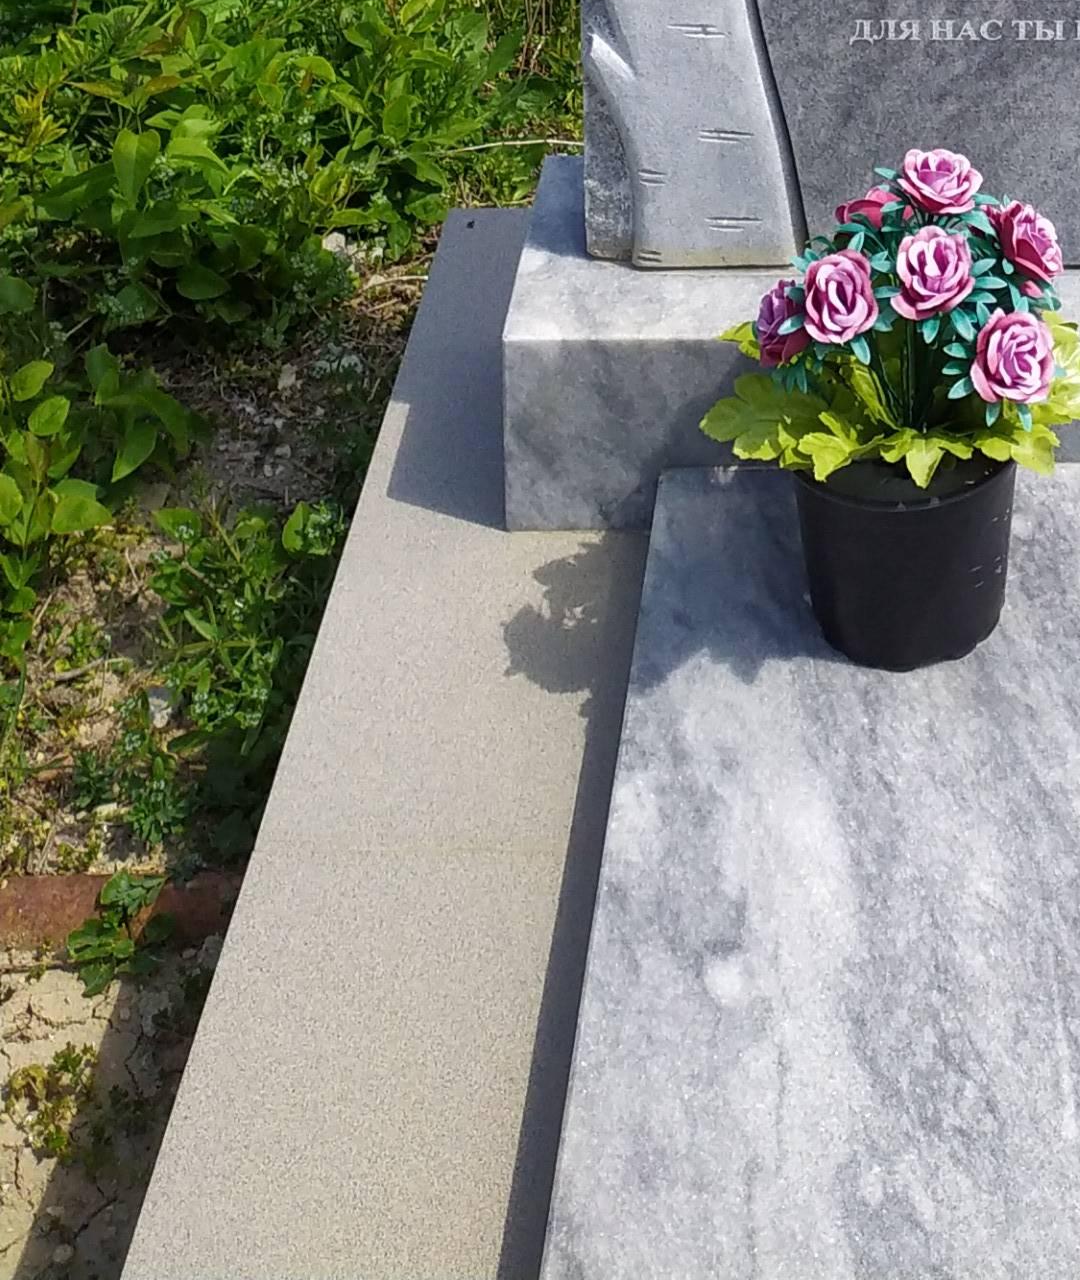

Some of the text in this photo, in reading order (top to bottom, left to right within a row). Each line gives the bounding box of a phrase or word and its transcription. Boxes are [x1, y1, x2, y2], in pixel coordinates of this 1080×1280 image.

[849, 19, 922, 45] ДЛЯ
[930, 19, 1004, 43] НАС
[1011, 20, 1066, 43] ТЫ
